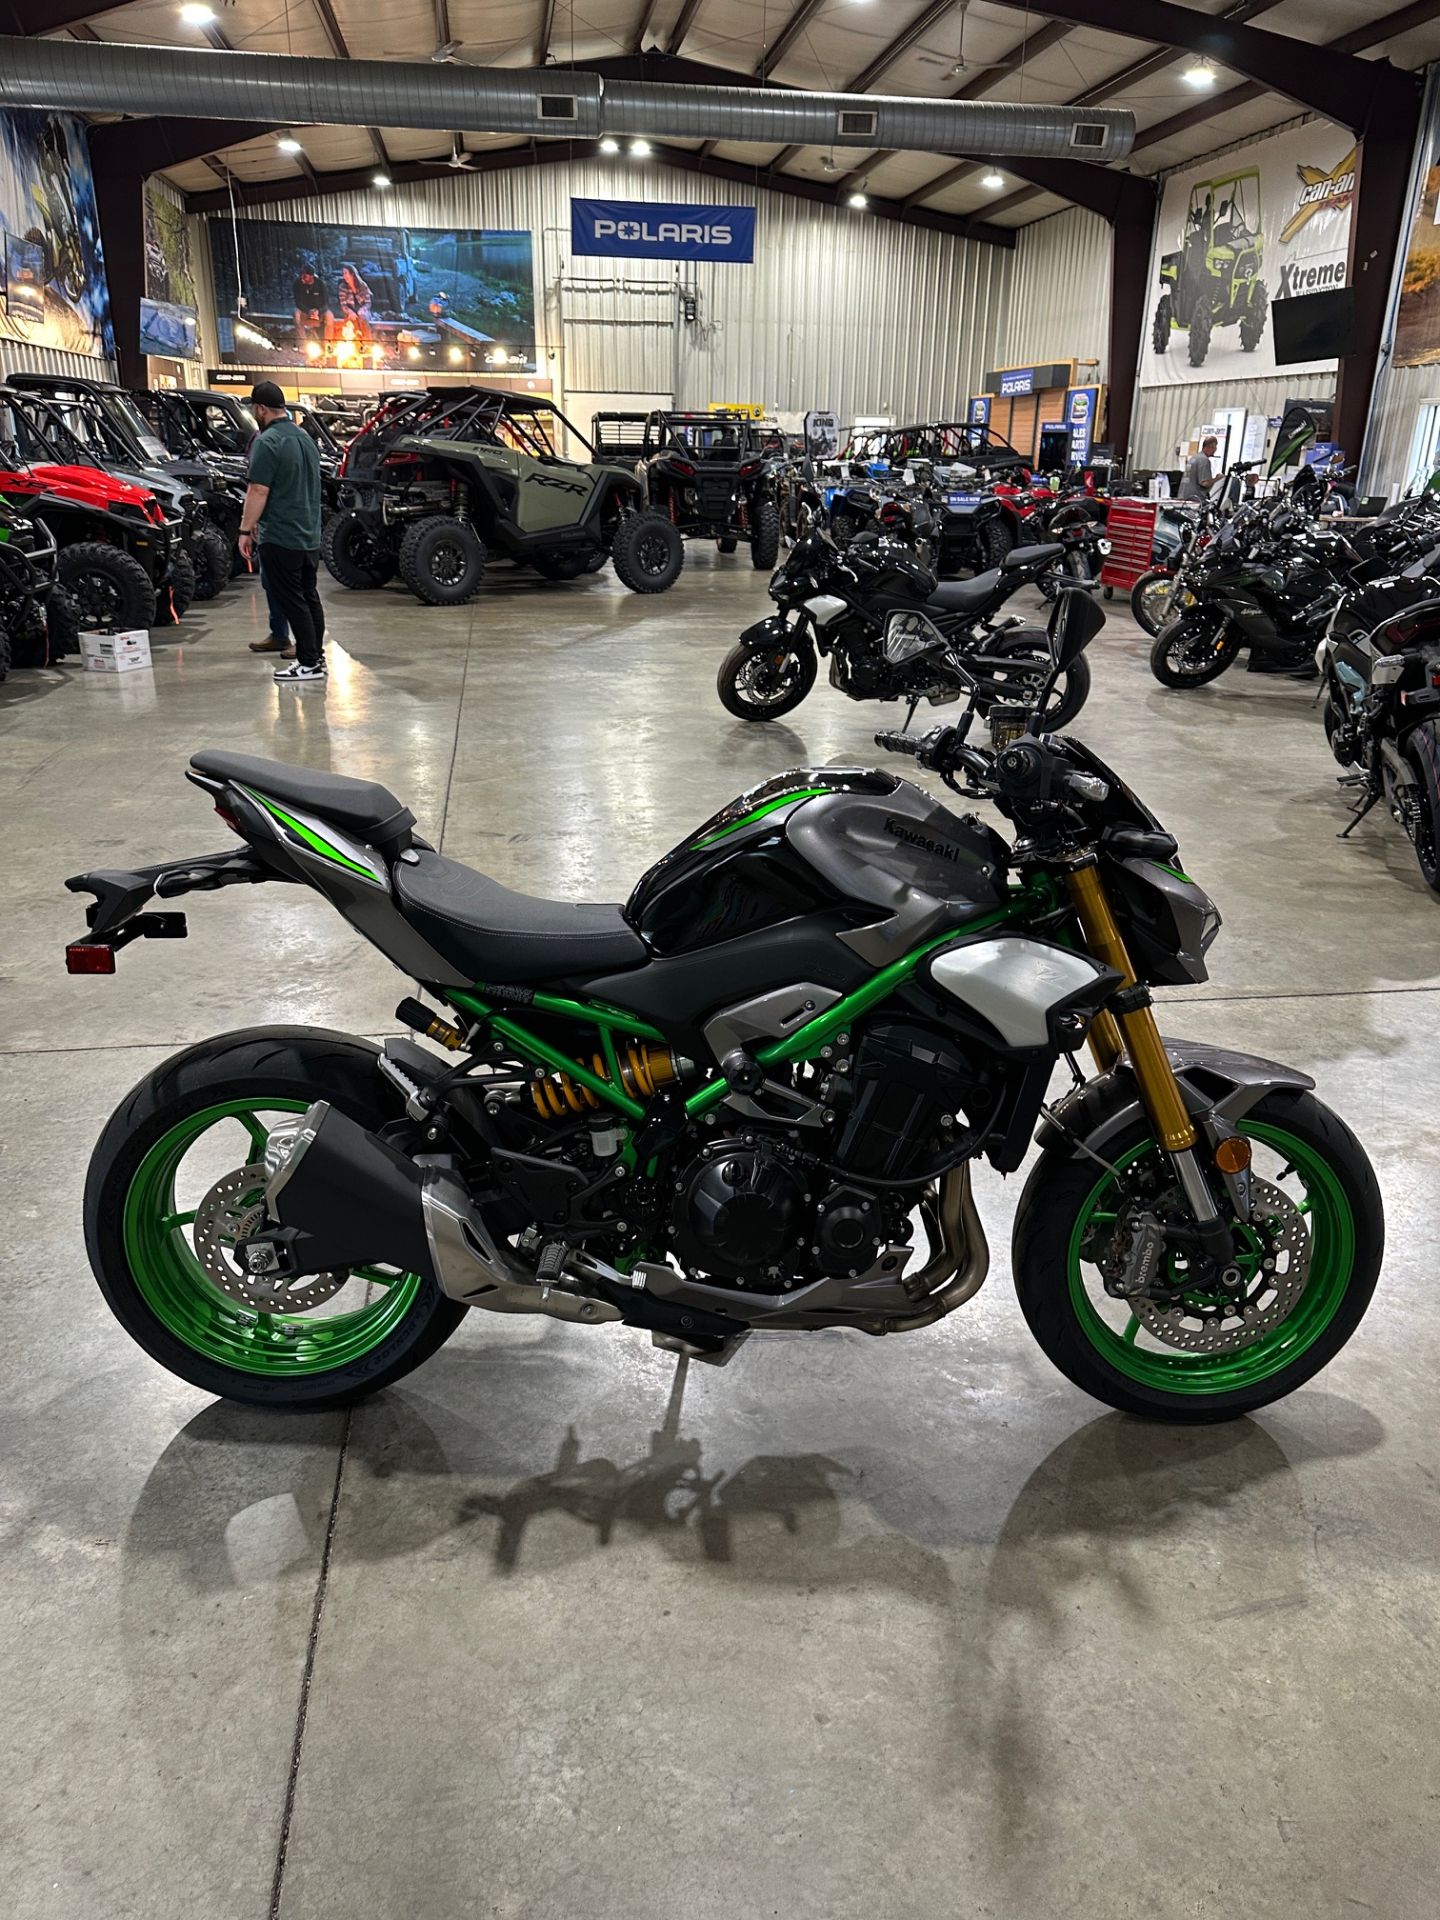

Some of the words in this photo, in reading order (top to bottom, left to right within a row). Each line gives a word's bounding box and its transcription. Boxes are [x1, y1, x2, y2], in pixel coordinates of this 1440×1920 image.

[594, 219, 733, 245] POLARIS
[1275, 261, 1346, 299] Xtreme
[1001, 379, 1031, 394] POLARIS
[813, 418, 834, 428] KING
[1072, 427, 1086, 438] ALES
[1071, 439, 1086, 449] ARTS
[1070, 451, 1087, 461] RVICE
[524, 472, 589, 497] RZR
[883, 817, 960, 862] Kawasaki
[1135, 1241, 1154, 1284] brembo
